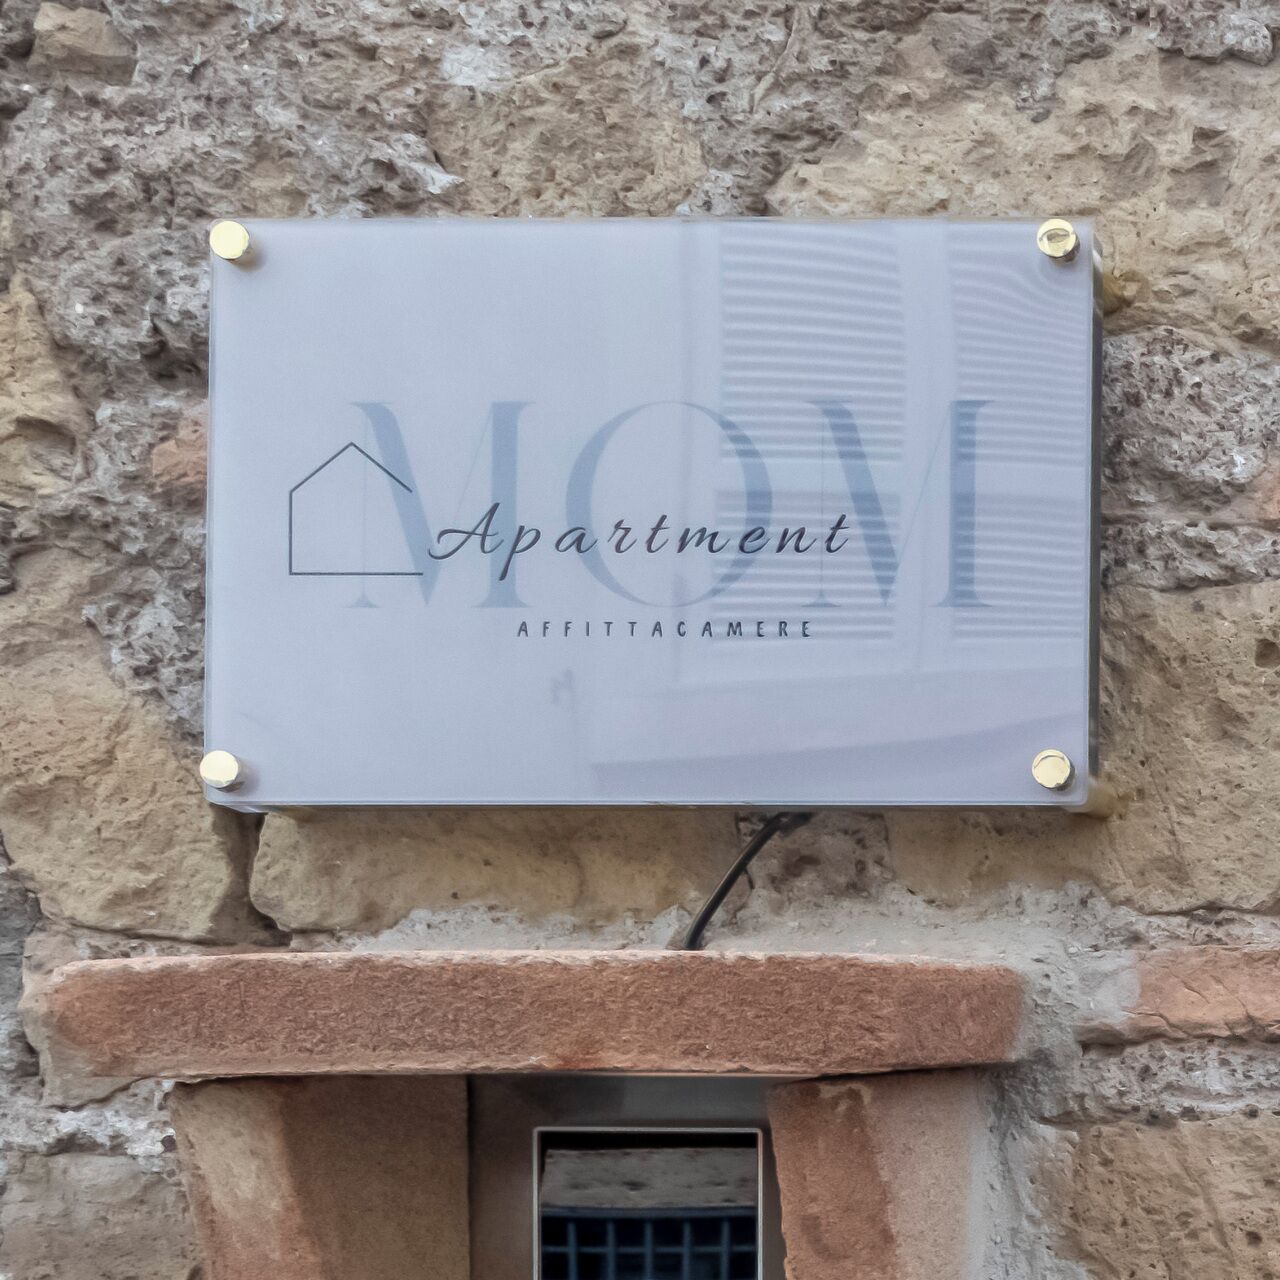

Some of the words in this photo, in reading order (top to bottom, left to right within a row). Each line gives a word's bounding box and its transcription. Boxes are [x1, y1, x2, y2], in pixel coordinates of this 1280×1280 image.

[346, 399, 1002, 609] MOM
[428, 502, 851, 581] Apartment
[516, 620, 812, 638] AFFITTACAMERE
